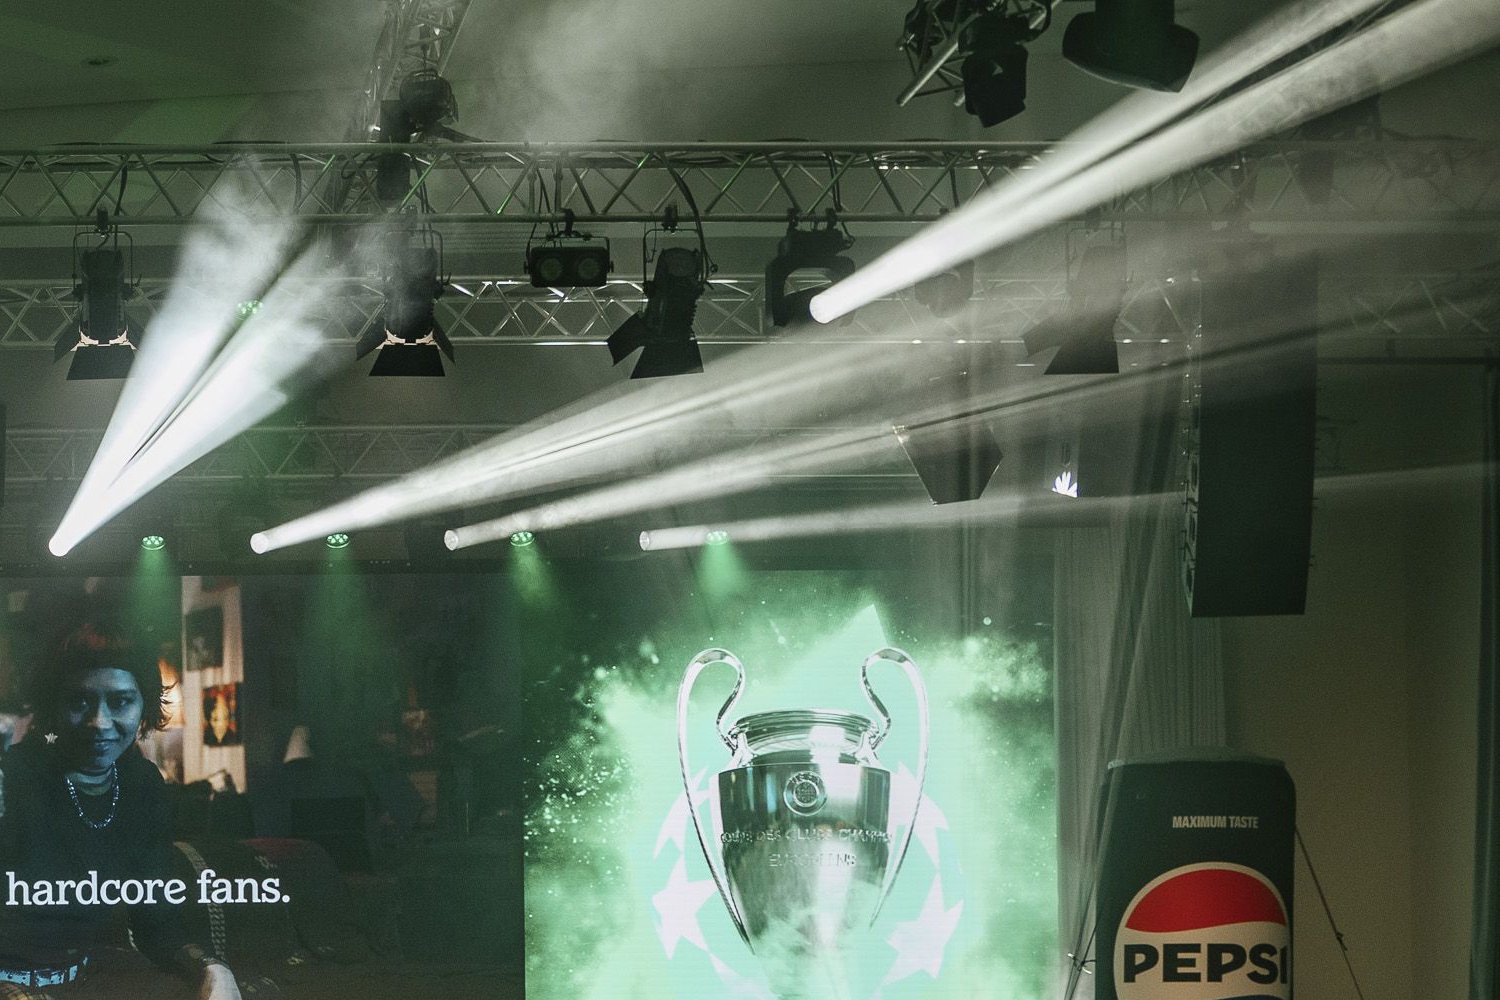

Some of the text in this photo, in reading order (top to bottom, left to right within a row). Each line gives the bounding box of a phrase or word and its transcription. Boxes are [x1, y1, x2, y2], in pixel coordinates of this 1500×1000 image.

[1172, 815, 1260, 829] MAXIMUM TASTE
[5, 870, 187, 906] hardcore
[197, 869, 291, 904] fans.
[1123, 943, 1288, 985] PEPSI
